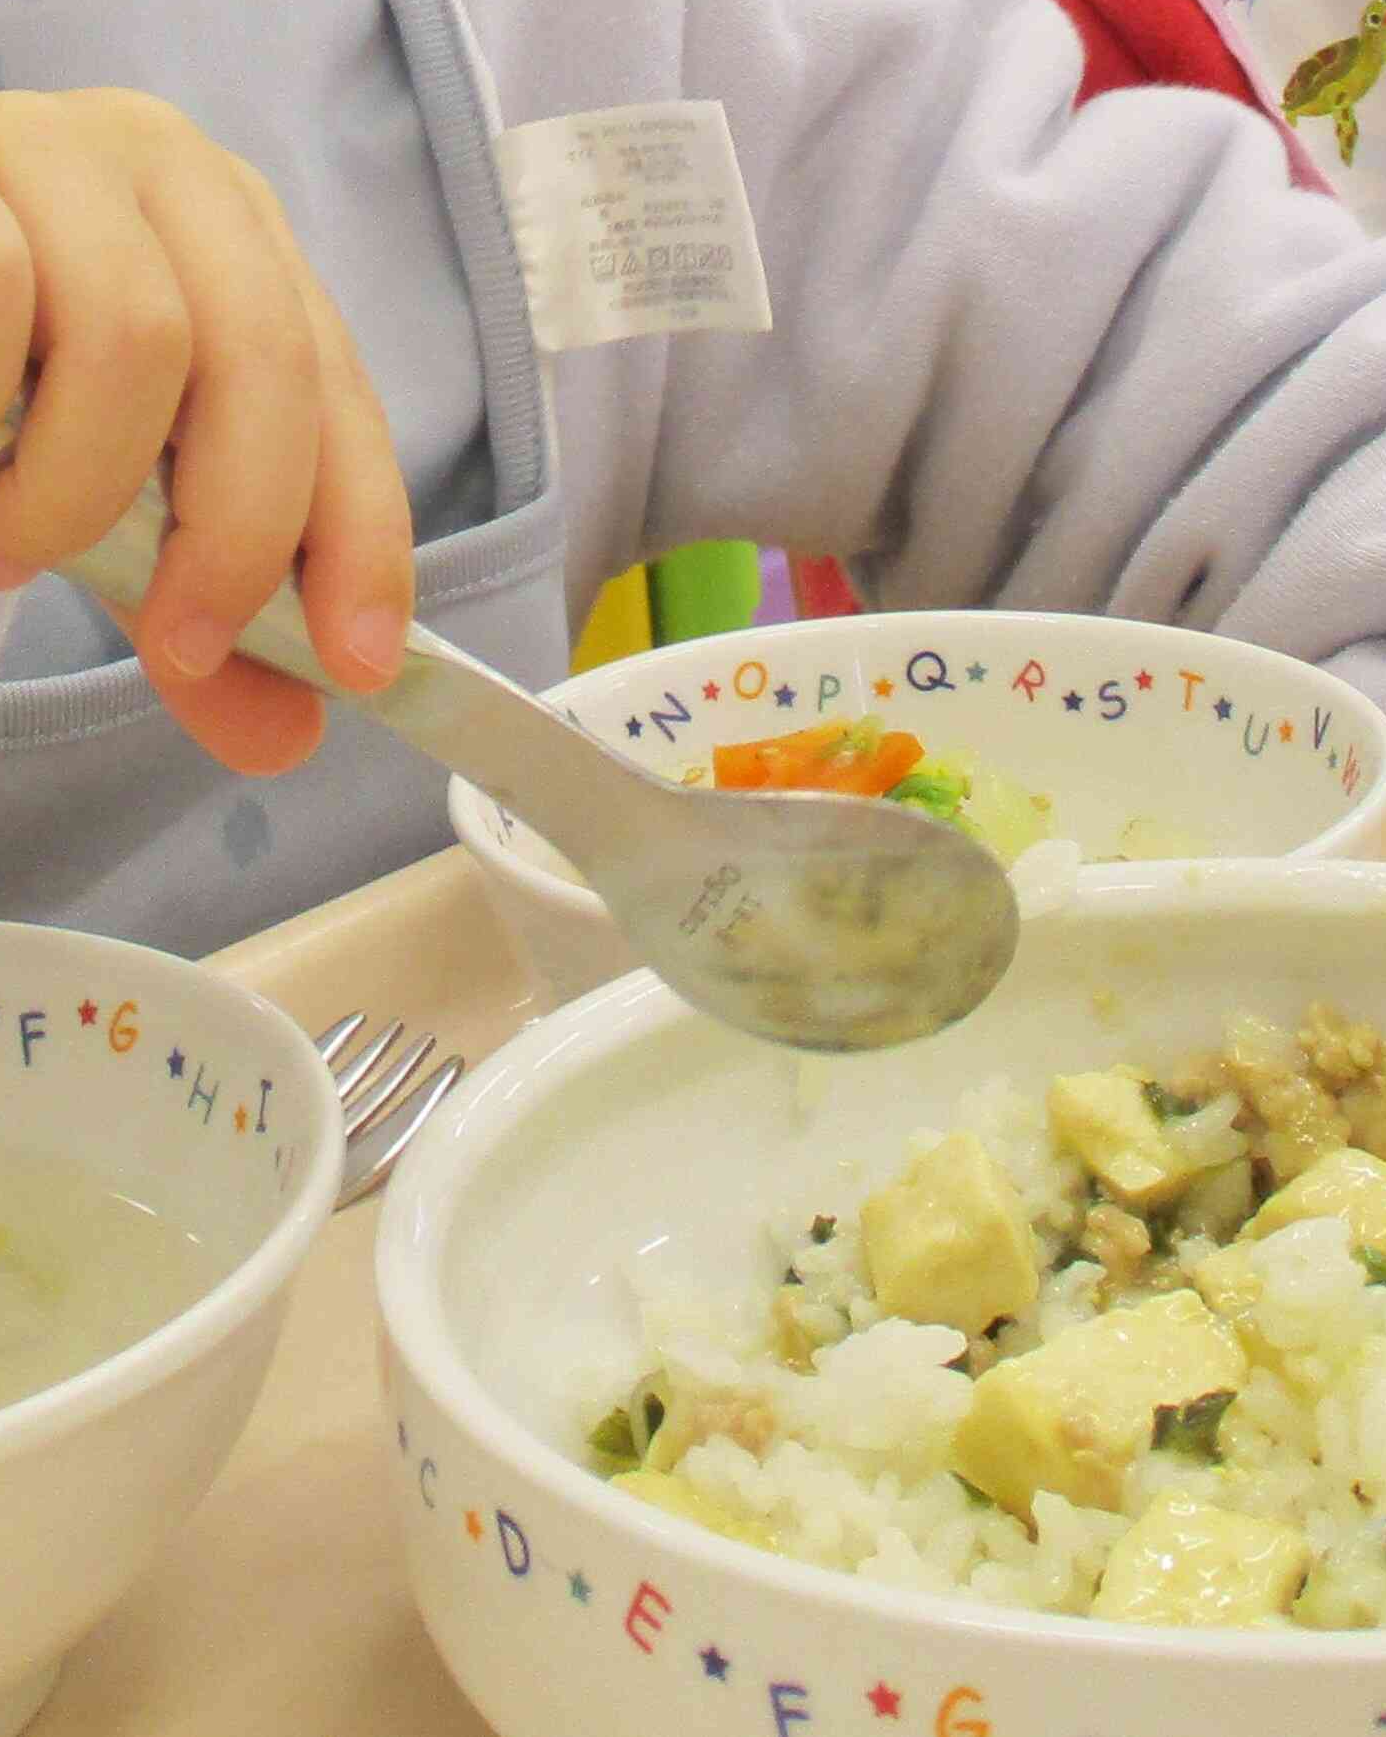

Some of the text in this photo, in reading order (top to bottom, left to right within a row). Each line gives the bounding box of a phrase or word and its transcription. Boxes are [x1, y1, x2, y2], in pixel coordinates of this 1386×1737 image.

[649, 691, 692, 743] N
[733, 660, 768, 701] O
[817, 673, 842, 713] P
[906, 650, 956, 692] Q
[1012, 658, 1046, 702] R
[1098, 680, 1128, 721] S
[1178, 668, 1206, 712] T
[1244, 713, 1269, 756] U
[1313, 706, 1332, 750] V
[18, 1011, 46, 1067] F
[108, 1000, 139, 1053] G
[187, 1063, 220, 1126] H
[254, 1078, 273, 1133] I
[494, 1509, 530, 1576] D
[624, 1579, 673, 1655] E
[769, 1682, 811, 1737] F
[935, 1685, 993, 1737] G
